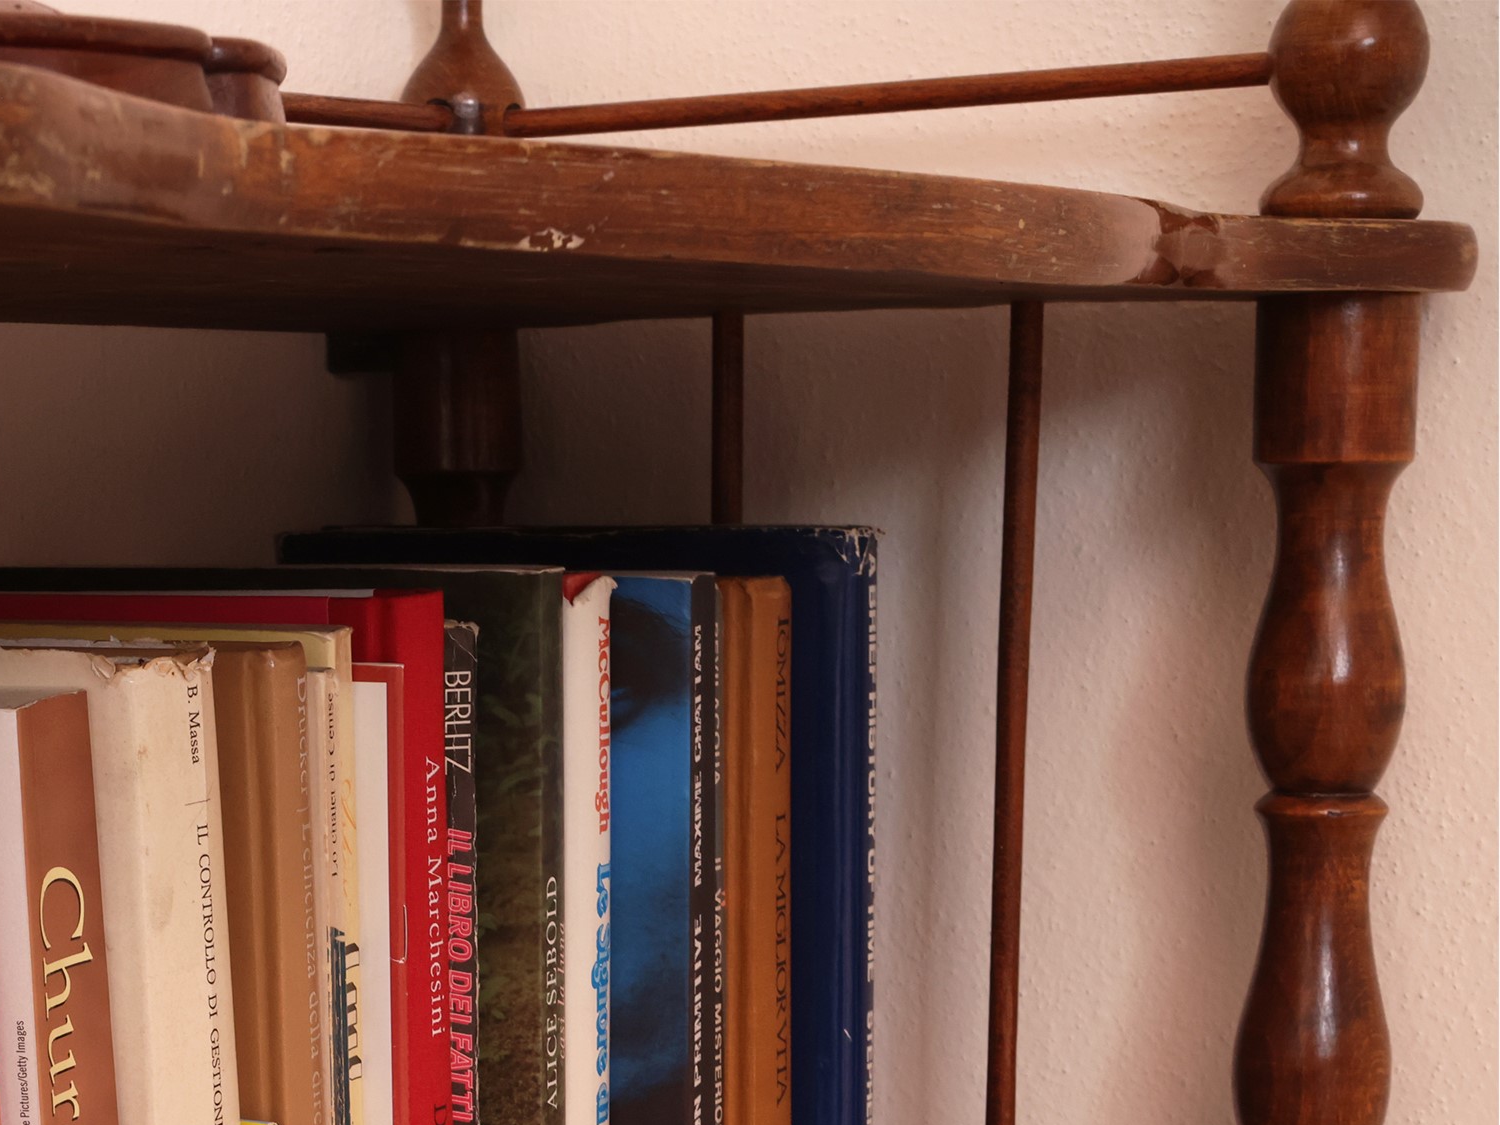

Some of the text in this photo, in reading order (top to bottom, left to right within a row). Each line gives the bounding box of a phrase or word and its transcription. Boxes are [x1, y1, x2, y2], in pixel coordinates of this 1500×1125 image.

[186, 685, 200, 704] B.
[187, 709, 201, 765] Massa
[444, 670, 472, 776] BERLITZ
[595, 615, 611, 836] McCullough
[196, 822, 209, 846] IL
[425, 756, 438, 844] Anna
[447, 828, 473, 856] IL
[692, 769, 703, 888] MAXIME
[198, 853, 218, 987] CONTROLLO
[447, 862, 473, 963] LIBRO
[596, 863, 611, 918] Le
[427, 855, 446, 1038] Marchesini
[16, 1020, 27, 1053] Images
[207, 993, 220, 1018] DI
[449, 968, 473, 1030] DEI
[546, 876, 559, 1111] ALICE SEBOLD
[692, 912, 703, 1085] PRIMITIVE
[449, 1033, 474, 1122] FATTI
